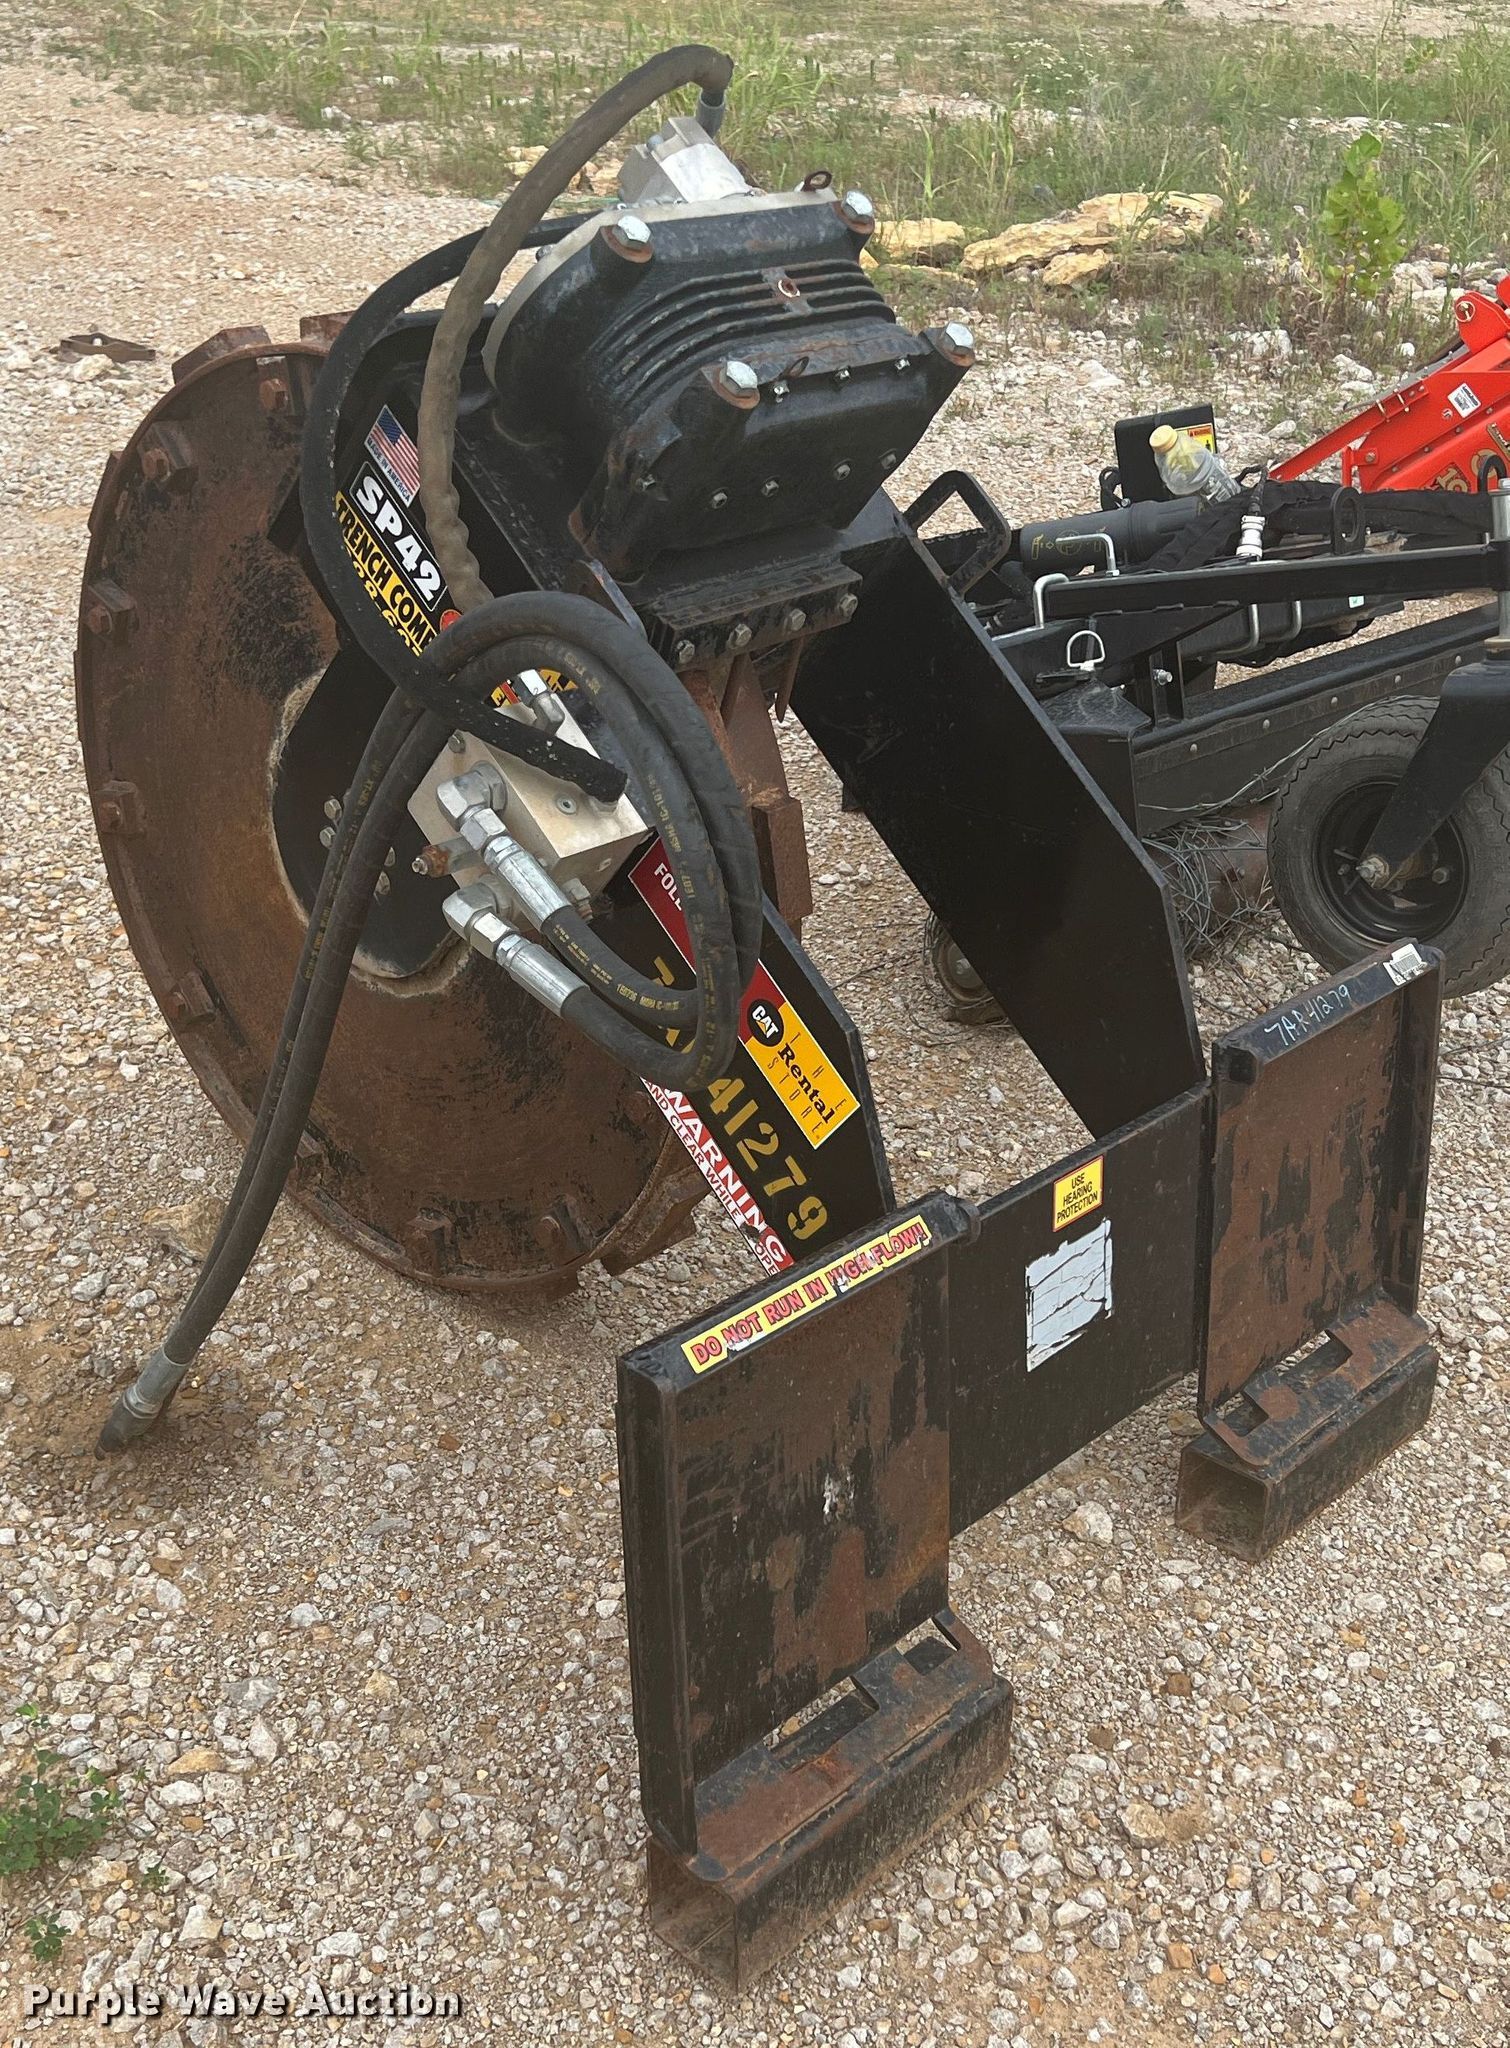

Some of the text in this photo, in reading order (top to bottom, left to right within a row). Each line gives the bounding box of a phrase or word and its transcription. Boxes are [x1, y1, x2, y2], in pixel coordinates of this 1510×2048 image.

[366, 437, 411, 502] MADE IN AMERICA
[337, 497, 392, 589] TRENCH
[356, 476, 441, 601] SP42
[752, 1005, 779, 1038] CAT
[777, 1042, 836, 1124] Rental
[664, 1088, 788, 1263] WARNING
[669, 1115, 705, 1166] CLEAR
[705, 1166, 741, 1220] WHILE
[707, 1078, 828, 1241] 41279
[1062, 1181, 1093, 1207] HEARING
[1071, 1172, 1086, 1189] USE
[1056, 1190, 1098, 1223] PROTECTION
[690, 1335, 723, 1366] DO
[721, 1311, 764, 1347] NOT
[762, 1289, 805, 1326] RUN
[801, 1277, 828, 1304] IN
[825, 1251, 873, 1289] HIGH
